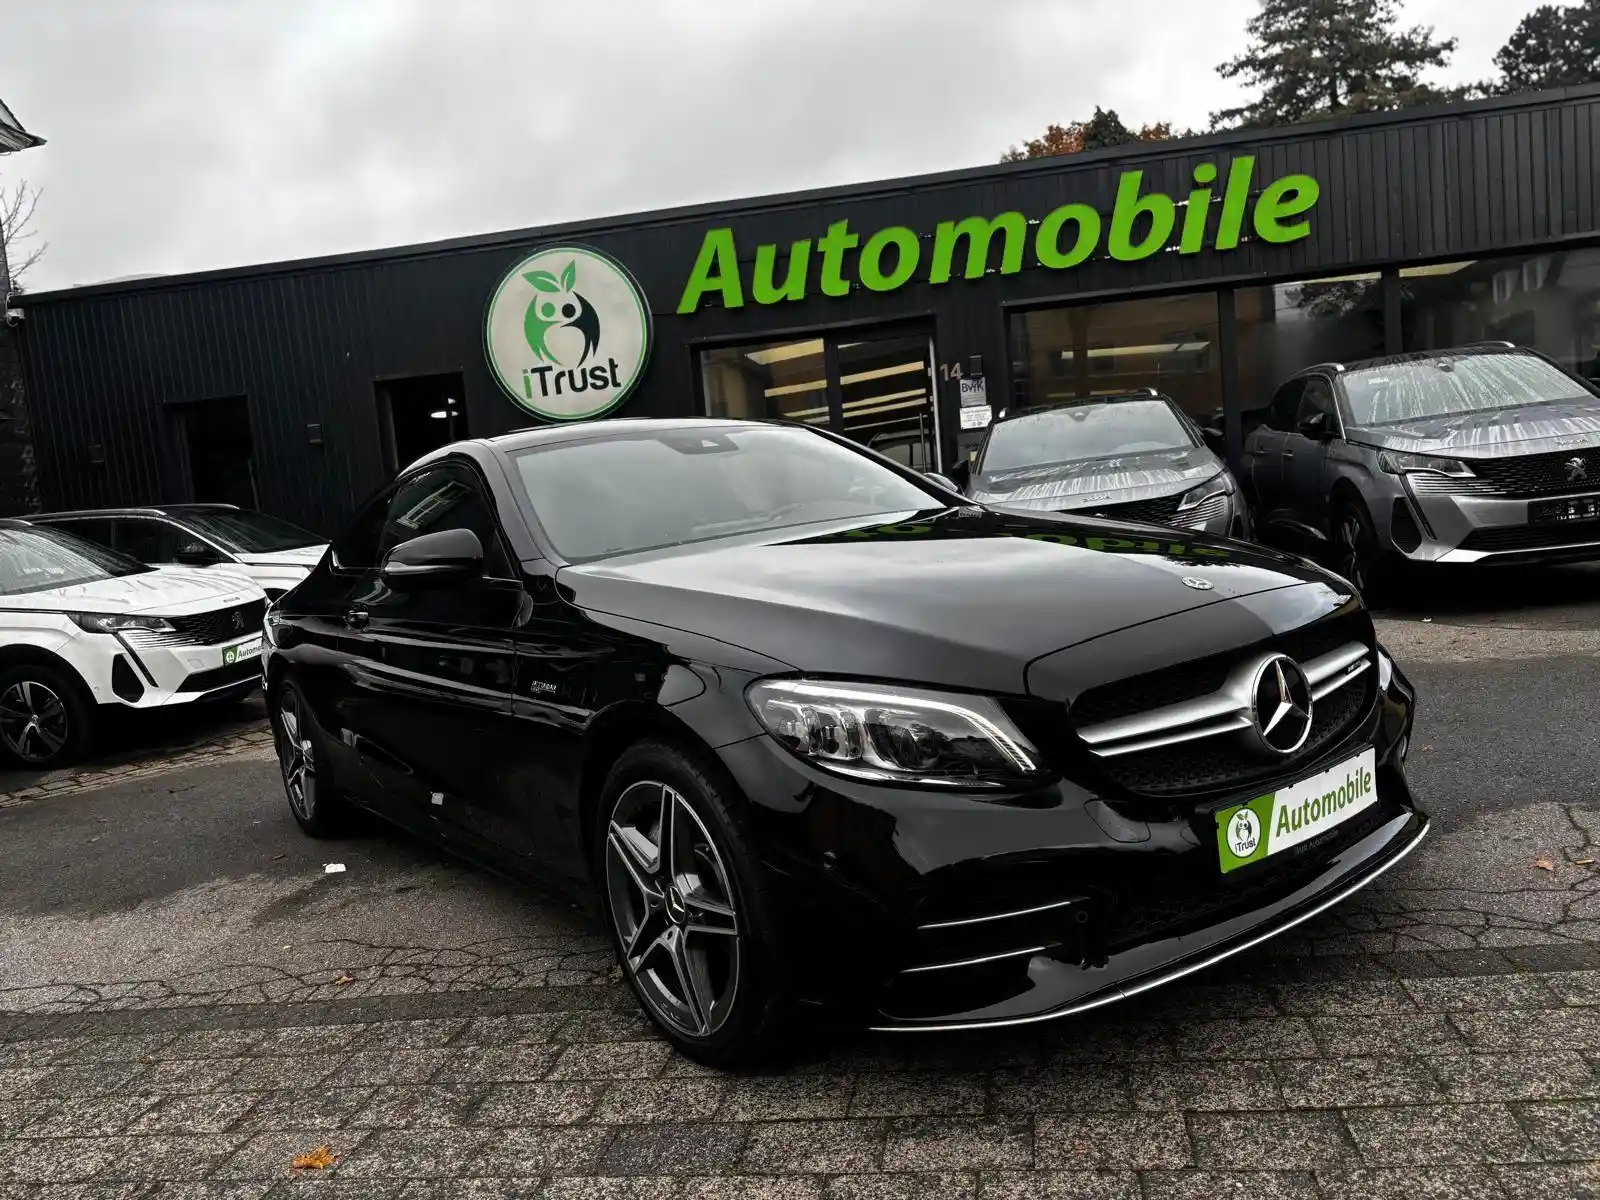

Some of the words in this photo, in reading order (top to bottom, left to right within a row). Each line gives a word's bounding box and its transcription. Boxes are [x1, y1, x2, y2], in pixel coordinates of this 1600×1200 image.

[677, 156, 1320, 314] Automobile
[522, 357, 621, 399] iTrust
[940, 362, 964, 381] 14
[1235, 837, 1256, 853] iTrust
[1276, 767, 1372, 838] Automobile
